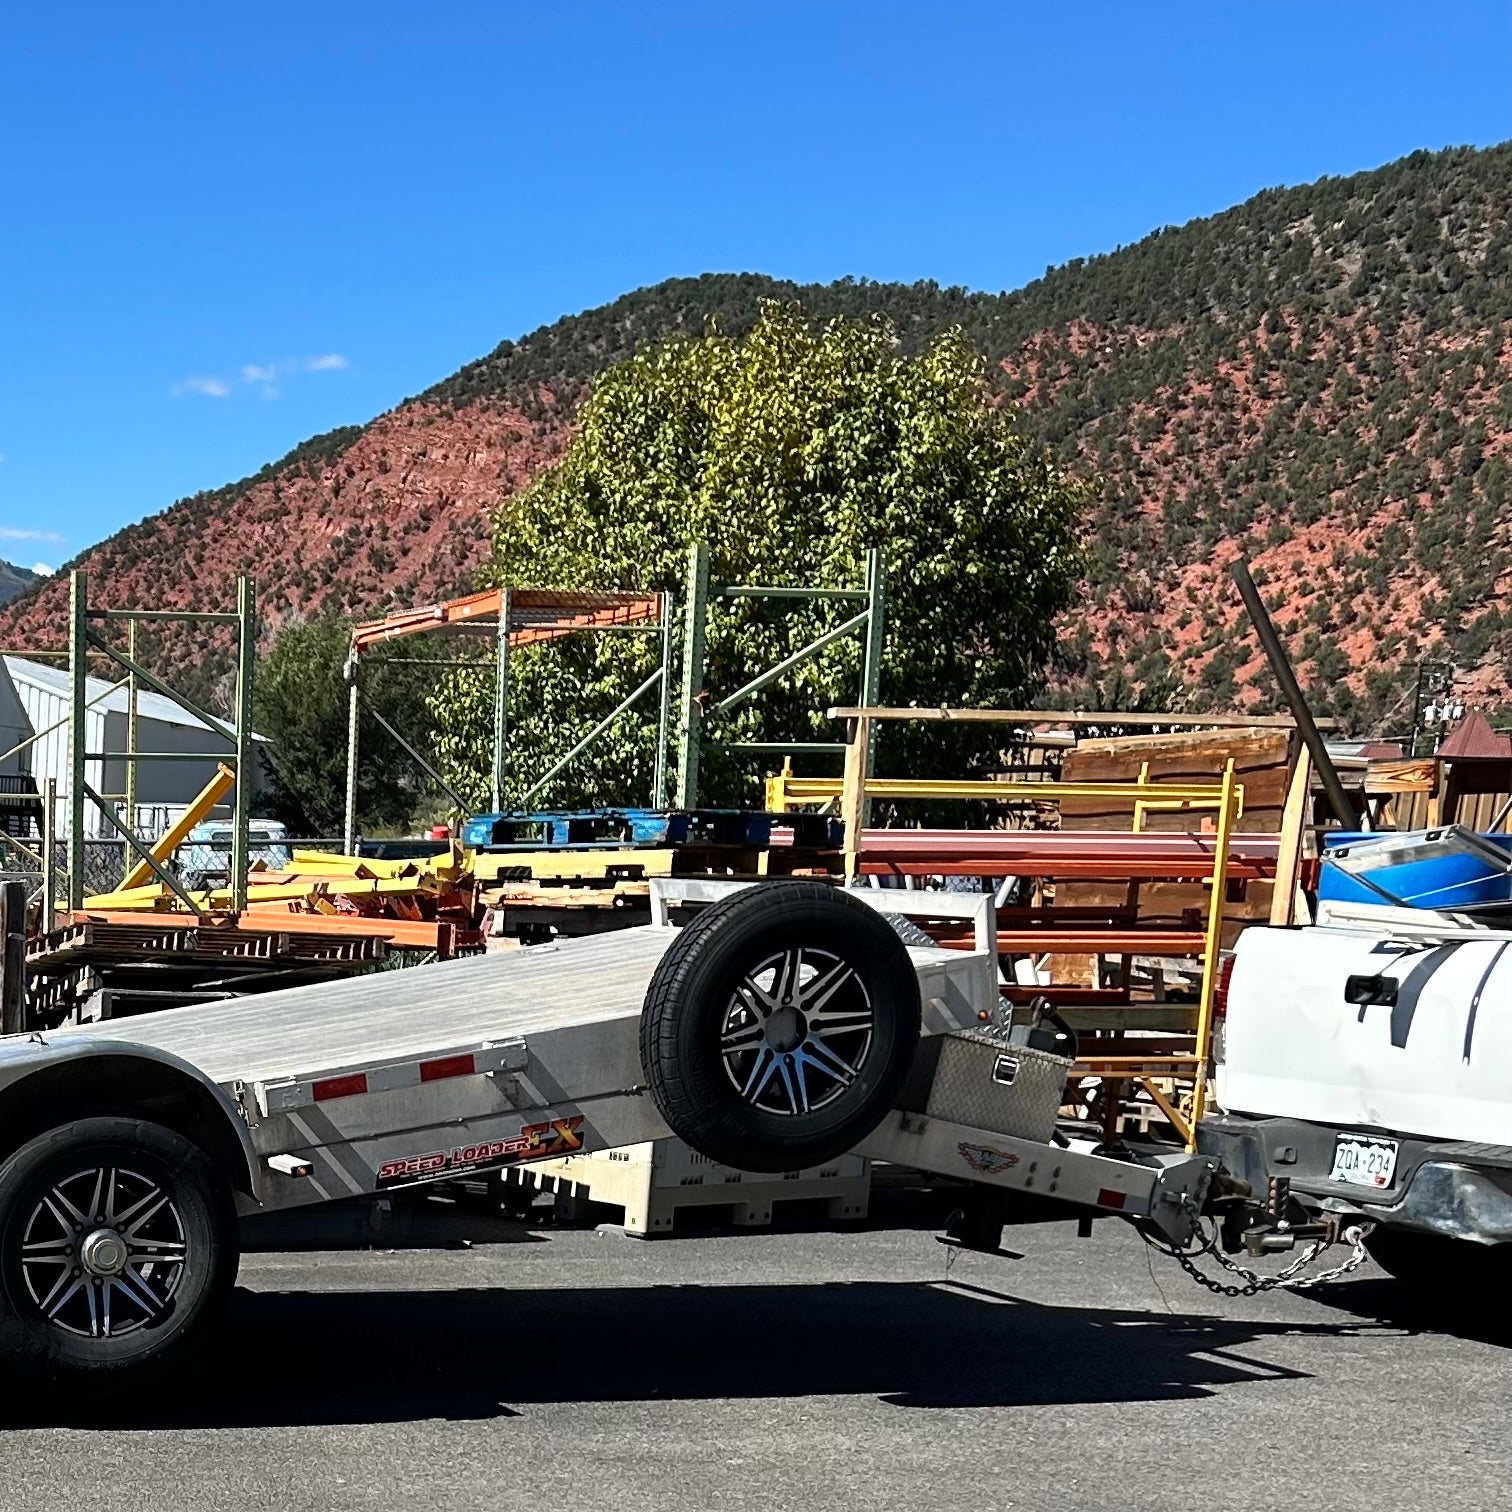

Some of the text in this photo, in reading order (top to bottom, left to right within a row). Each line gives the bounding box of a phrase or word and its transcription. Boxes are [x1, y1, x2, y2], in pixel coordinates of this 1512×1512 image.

[379, 1151, 446, 1178] SPEED
[450, 1136, 530, 1164] LOADER
[519, 1116, 584, 1159] EX
